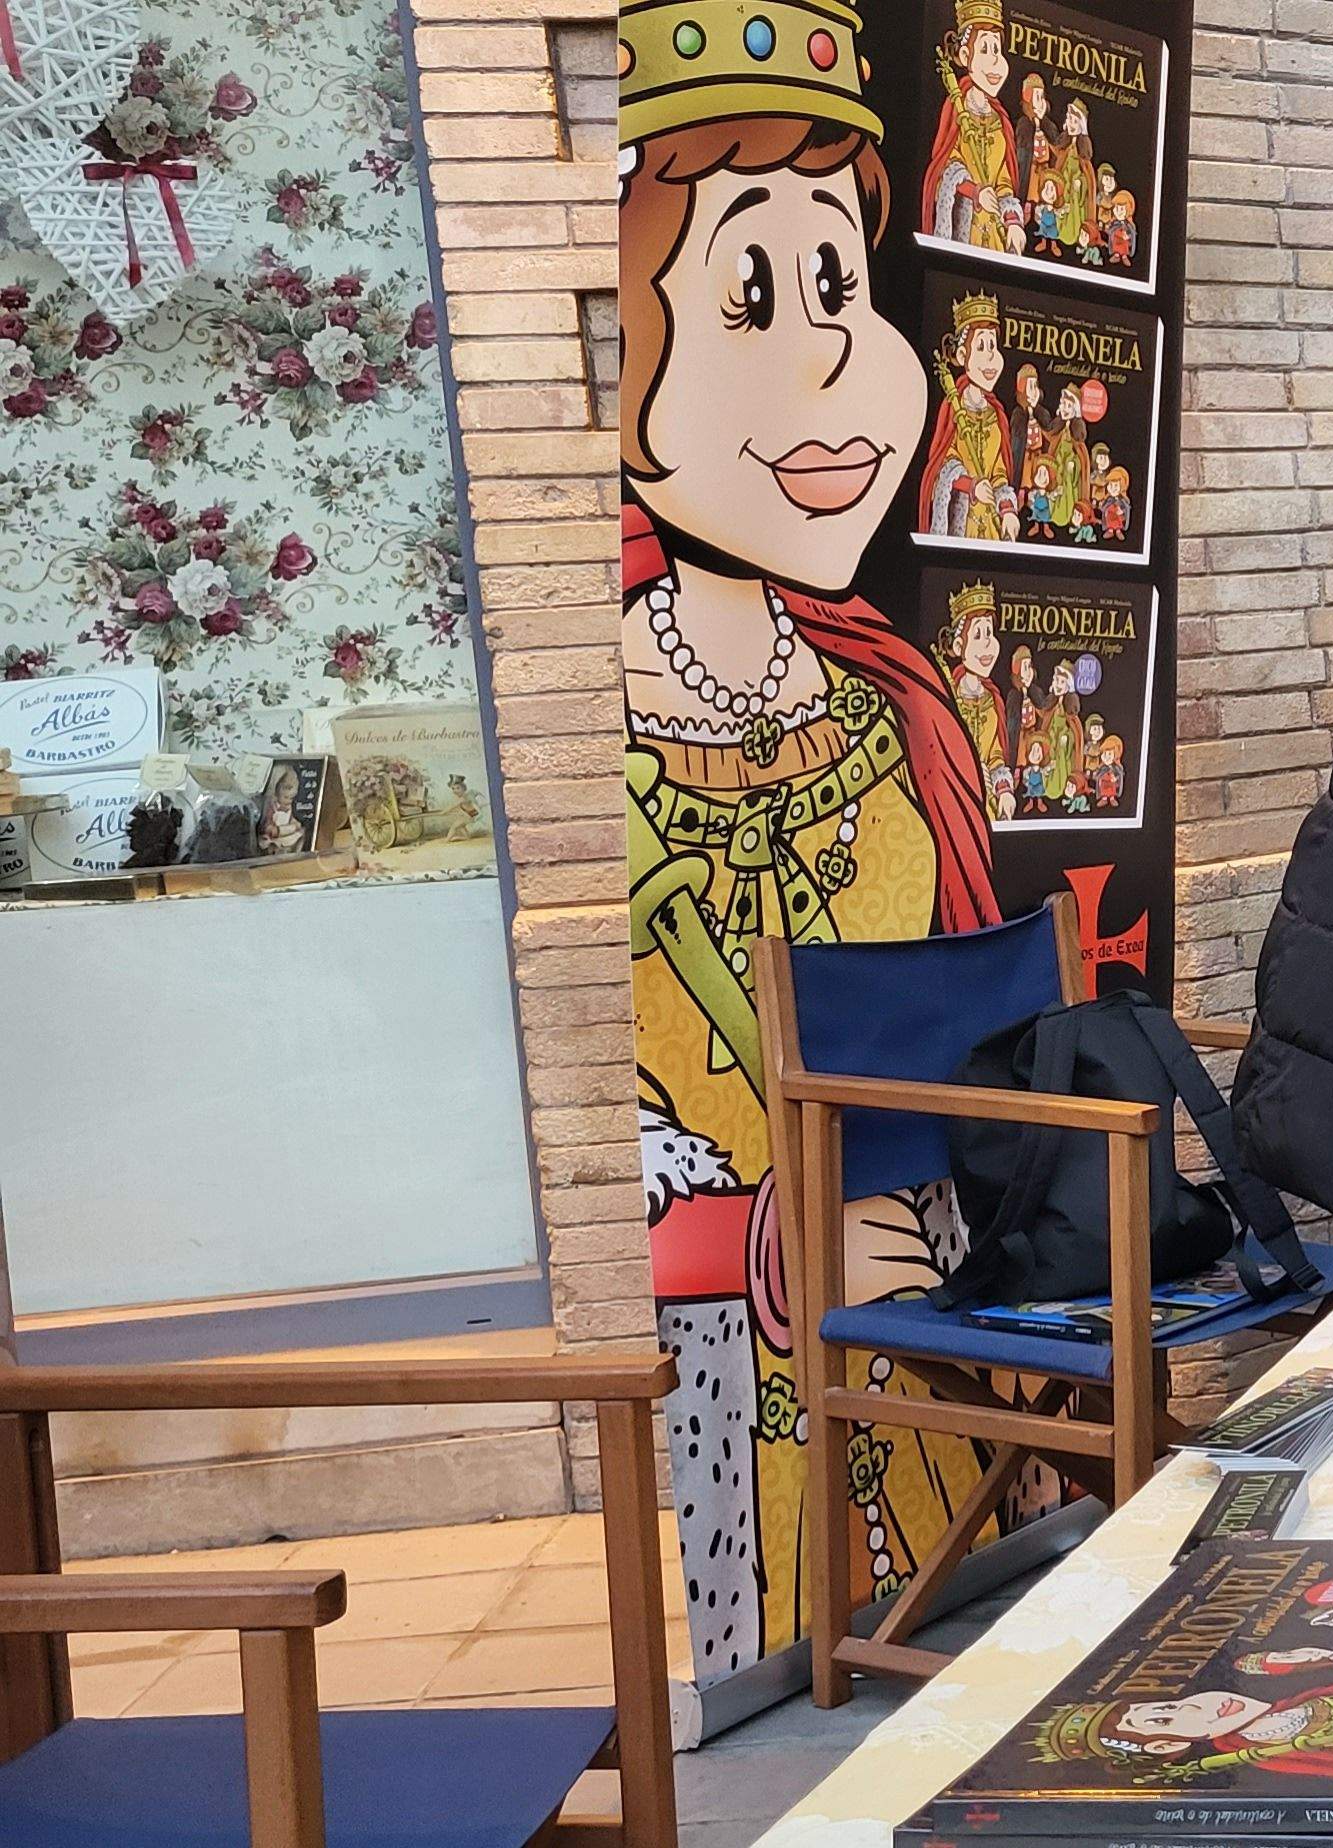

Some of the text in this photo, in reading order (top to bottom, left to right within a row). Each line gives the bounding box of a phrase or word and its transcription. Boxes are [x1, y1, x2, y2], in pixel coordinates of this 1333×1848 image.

[1008, 21, 1147, 93] PETRONILA
[1003, 317, 1142, 371] PEIRONELA
[999, 603, 1136, 639] PERONELLA
[53, 689, 116, 703] BIARRITZ
[31, 702, 111, 737] Albás
[344, 730, 388, 745] Dulces
[392, 729, 409, 743] de
[25, 740, 116, 762] BARBASTRO
[1098, 944, 1112, 958] de
[1205, 1387, 1320, 1445] PETRONILA
[1213, 1474, 1277, 1537] PETRONILA
[1112, 1546, 1310, 1695] PEIRONELA
[1187, 1809, 1196, 1820] o
[1277, 1809, 1287, 1825] A
